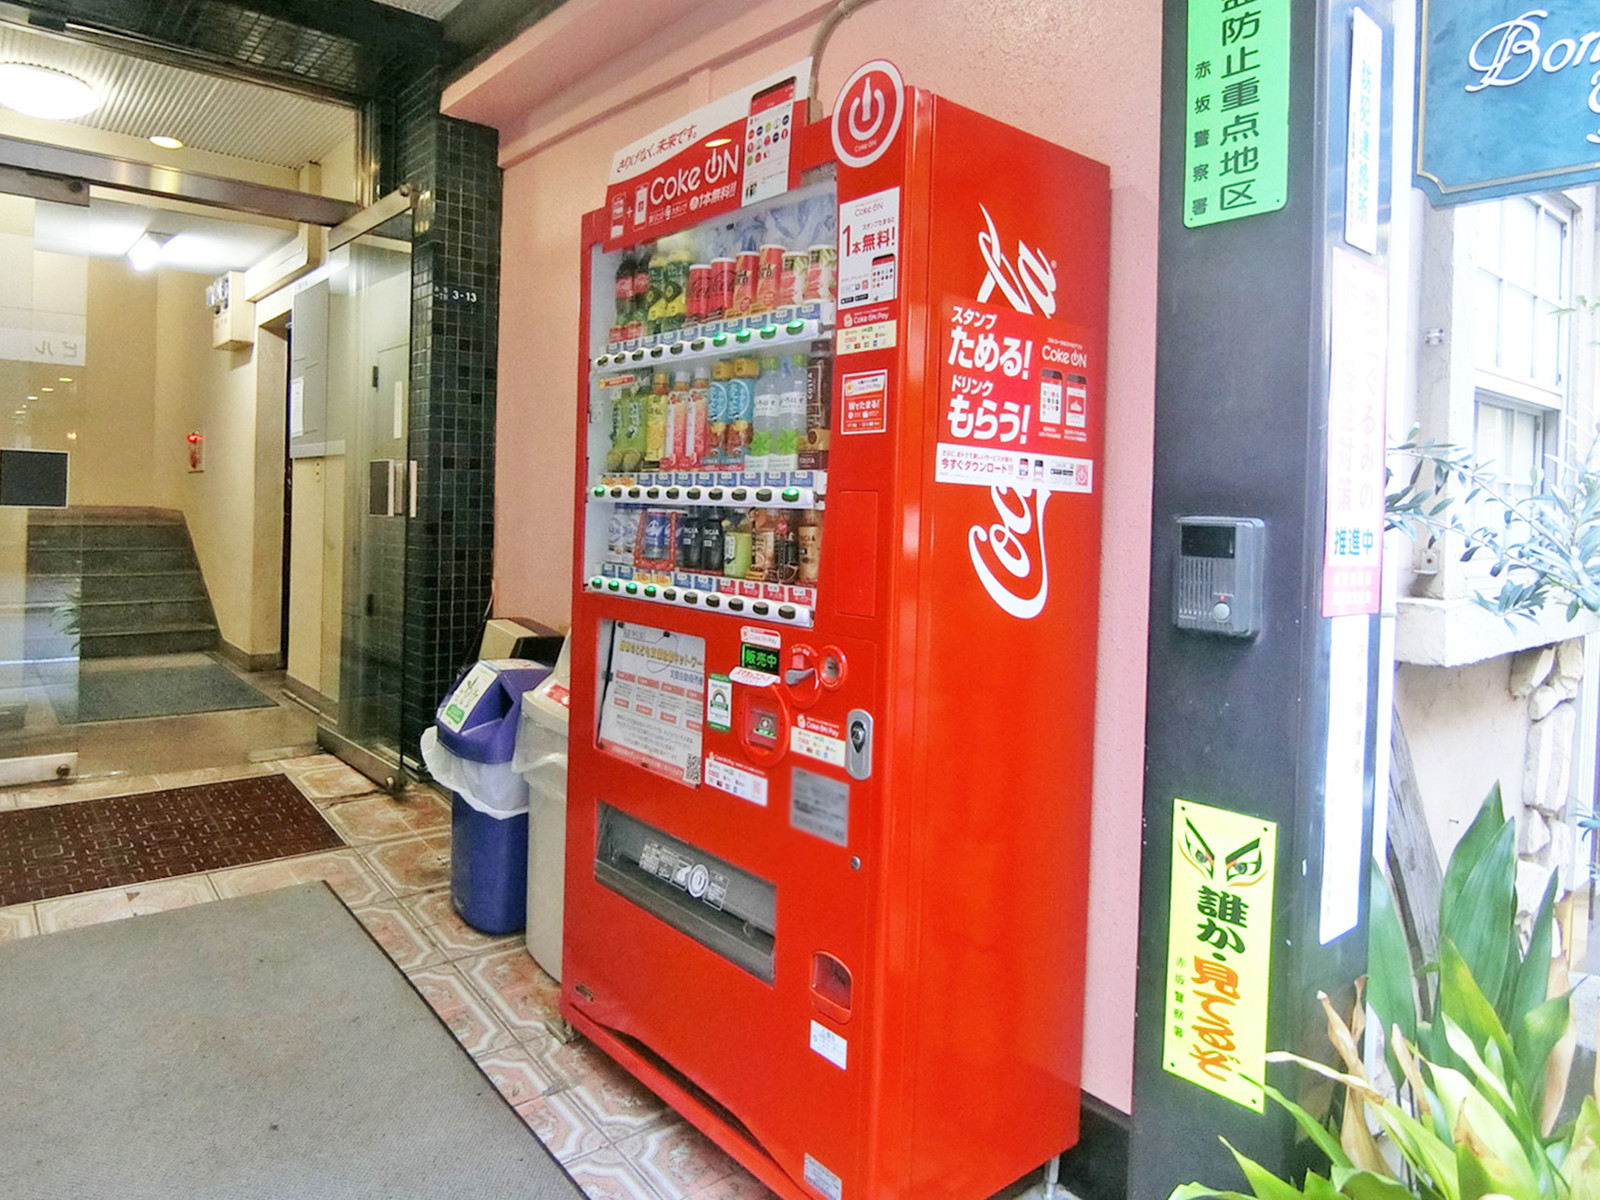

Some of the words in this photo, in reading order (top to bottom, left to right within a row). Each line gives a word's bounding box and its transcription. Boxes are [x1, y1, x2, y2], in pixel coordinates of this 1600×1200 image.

[1219, 0, 1261, 211] 防止重点地区
[1192, 60, 1211, 216] 赤坂警察署
[649, 166, 701, 206] Coke
[703, 143, 740, 184] ON
[842, 225, 896, 258] 1本無料!
[452, 289, 478, 303] 3-13
[951, 305, 998, 330] スタンプ
[947, 327, 1033, 380] ためる!
[1041, 344, 1070, 365] Coke
[1070, 349, 1088, 369] ON
[951, 373, 994, 398] ドリンク
[946, 393, 1032, 445] もらう!
[1333, 525, 1374, 556] 推進中
[745, 649, 778, 668] 販売中
